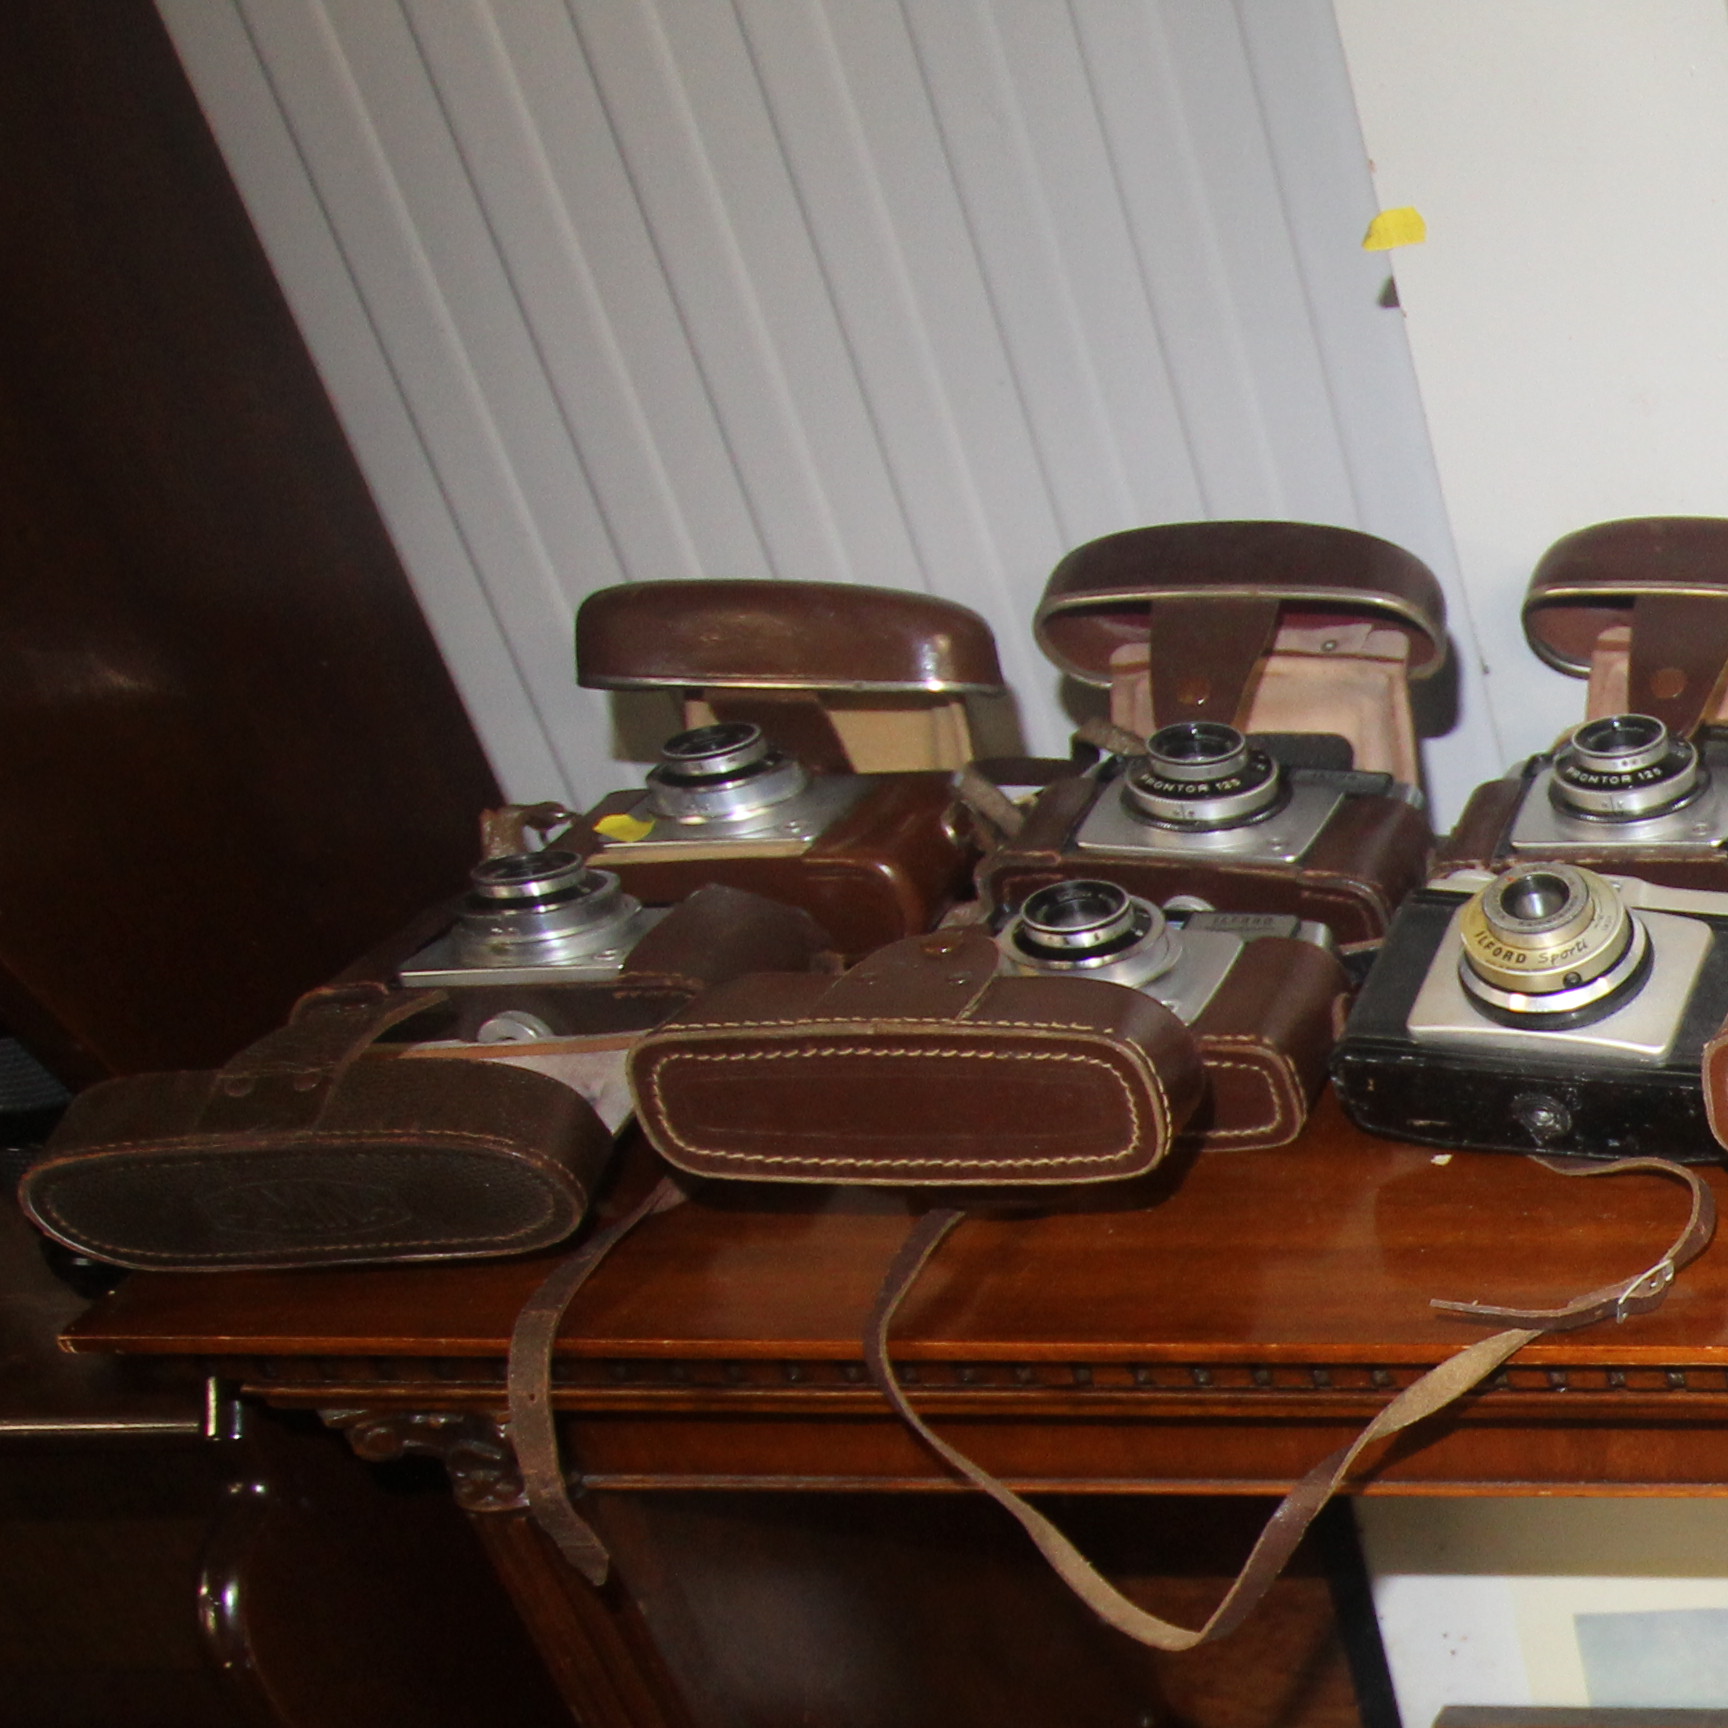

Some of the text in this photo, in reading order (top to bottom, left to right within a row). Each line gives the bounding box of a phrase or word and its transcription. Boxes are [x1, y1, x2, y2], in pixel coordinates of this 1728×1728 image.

[1140, 772, 1210, 794] PRONTOR
[1565, 765, 1633, 785] PRONTOR
[1474, 930, 1589, 966] ILFORD Sporti
